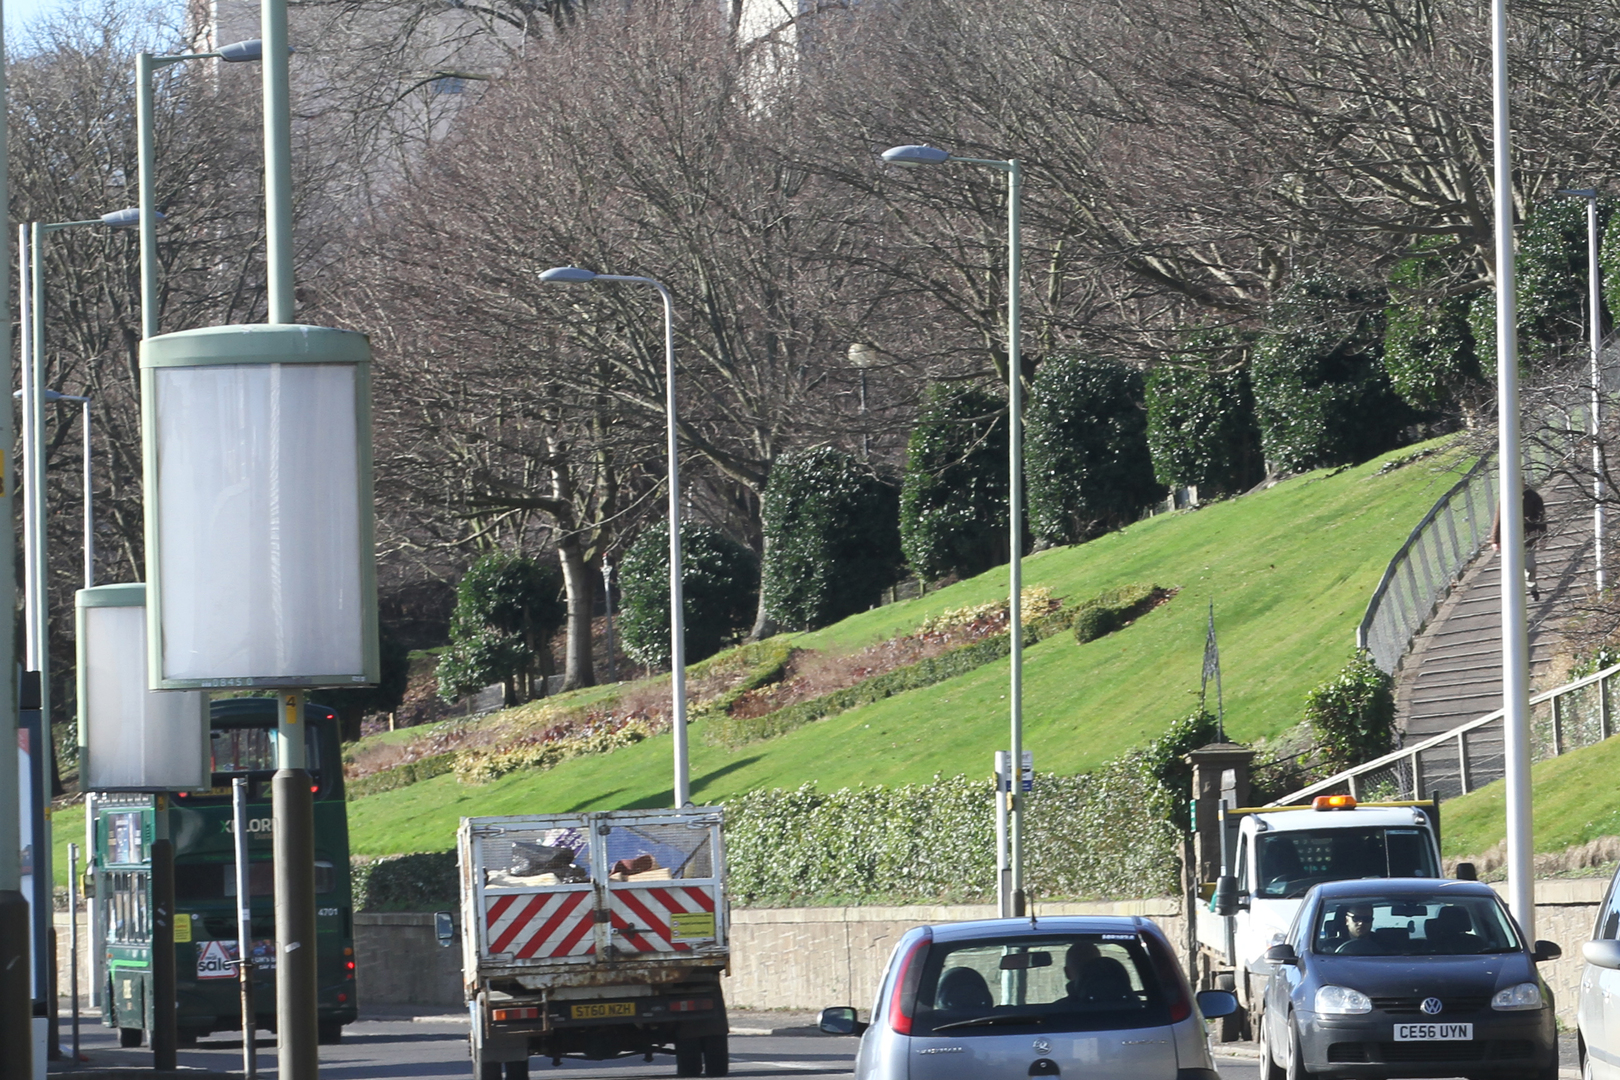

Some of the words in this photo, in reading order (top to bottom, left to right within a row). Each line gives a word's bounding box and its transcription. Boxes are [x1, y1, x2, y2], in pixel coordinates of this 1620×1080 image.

[198, 958, 232, 973] sale
[1400, 1025, 1436, 1039] CE56
[1440, 1025, 1467, 1038] UYN
